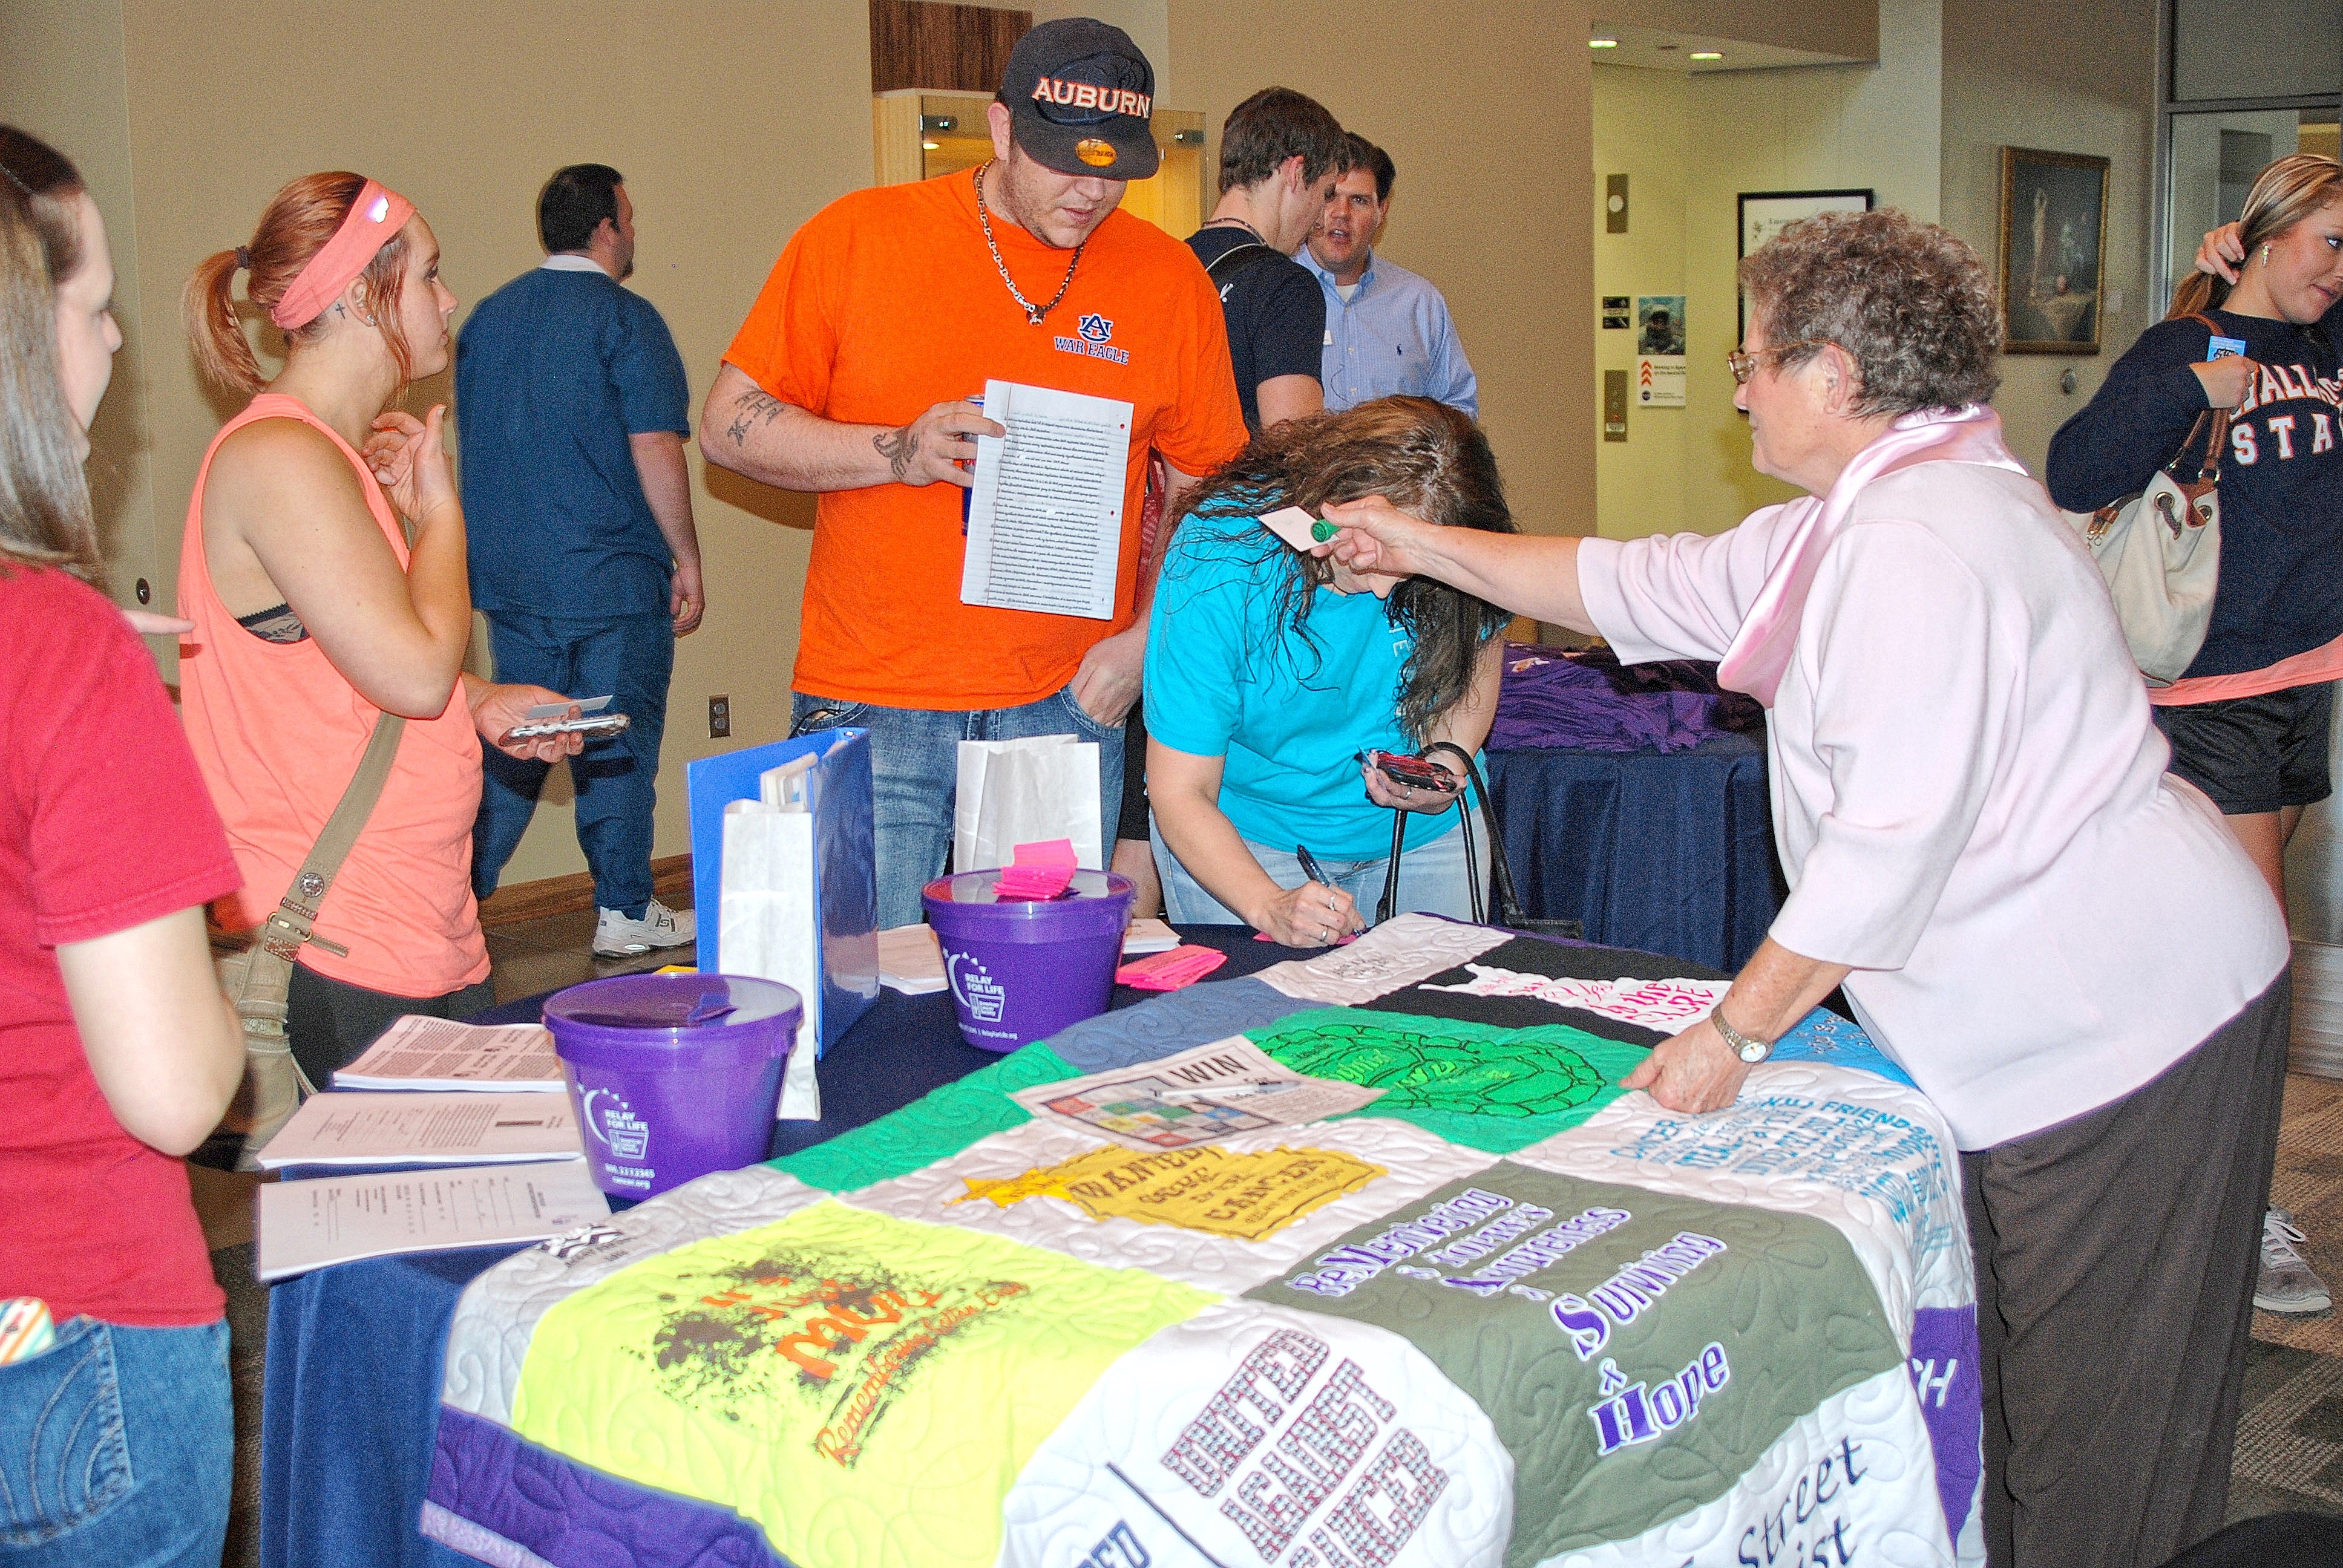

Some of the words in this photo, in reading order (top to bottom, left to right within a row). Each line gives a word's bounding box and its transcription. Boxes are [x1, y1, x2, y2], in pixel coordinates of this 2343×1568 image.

[1031, 76, 1151, 119] AUBURN
[1054, 336, 1085, 355] WAR
[1087, 342, 1129, 366] EAGLE
[2232, 412, 2343, 466] STA
[965, 973, 993, 985] RELAY
[966, 982, 984, 993] FOR
[984, 985, 1005, 996] LIFE
[1168, 1054, 1249, 1085] WIN
[605, 1109, 636, 1121] RELAY
[606, 1120, 625, 1129] FOR
[626, 1120, 649, 1131] LIFE
[1160, 1330, 1331, 1498] UNITED
[1587, 1341, 1730, 1455] Hope
[1220, 1357, 1396, 1565] AGAINST
[1738, 1434, 1868, 1568] Street
